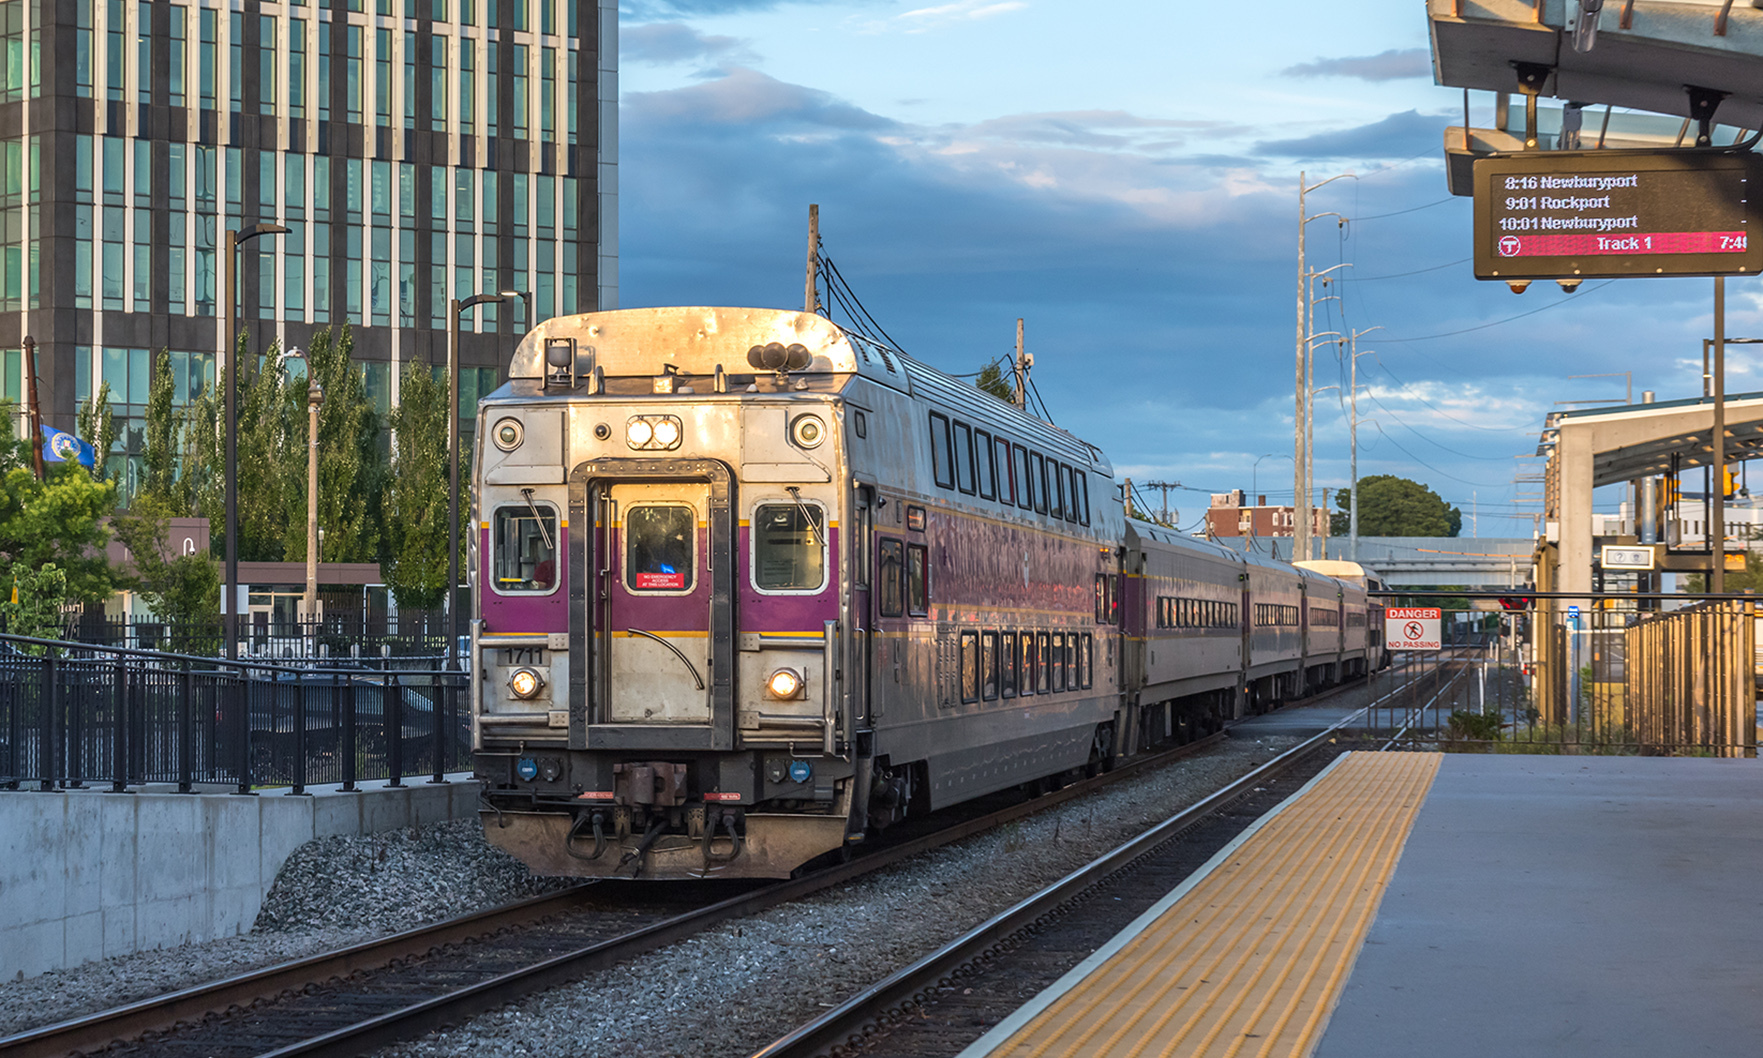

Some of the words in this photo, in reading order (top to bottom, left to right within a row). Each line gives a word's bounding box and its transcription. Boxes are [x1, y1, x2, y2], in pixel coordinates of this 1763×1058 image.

[1505, 176, 1538, 190] 8:16
[1540, 174, 1638, 191] Newburyport
[1505, 196, 1537, 210] 9:01
[1540, 195, 1610, 212] Rockport
[1499, 217, 1538, 230] 10:01
[1540, 215, 1638, 232] Newburyport
[1500, 238, 1519, 255] T
[1597, 237, 1639, 250] Track
[1644, 236, 1652, 249] 1
[1389, 609, 1437, 618] DANGER
[505, 648, 543, 664] 1711
